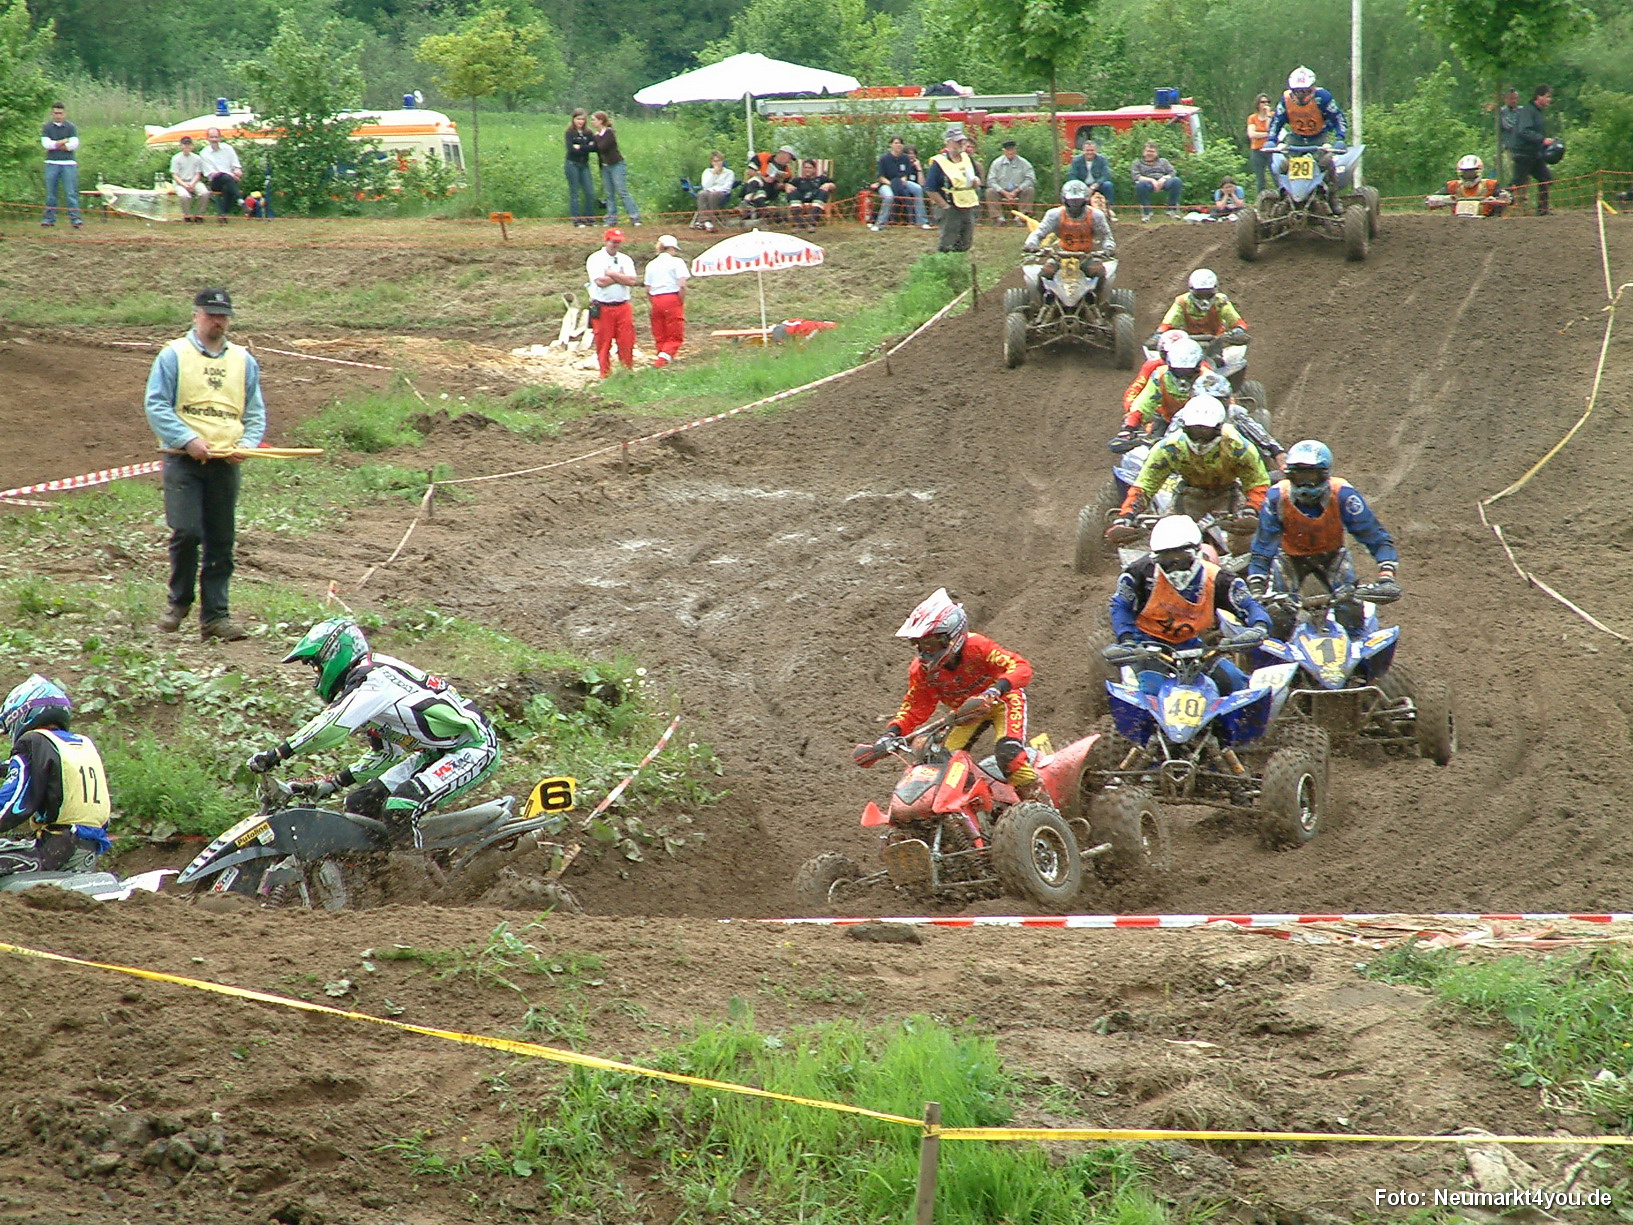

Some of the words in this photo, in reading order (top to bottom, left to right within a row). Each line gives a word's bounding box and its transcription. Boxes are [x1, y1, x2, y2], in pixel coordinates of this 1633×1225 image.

[1291, 161, 1310, 177] 29
[203, 367, 227, 378] ADAC
[1315, 638, 1336, 664] 1
[1167, 698, 1200, 718] 40
[79, 765, 101, 804] 12
[539, 780, 573, 811] 6
